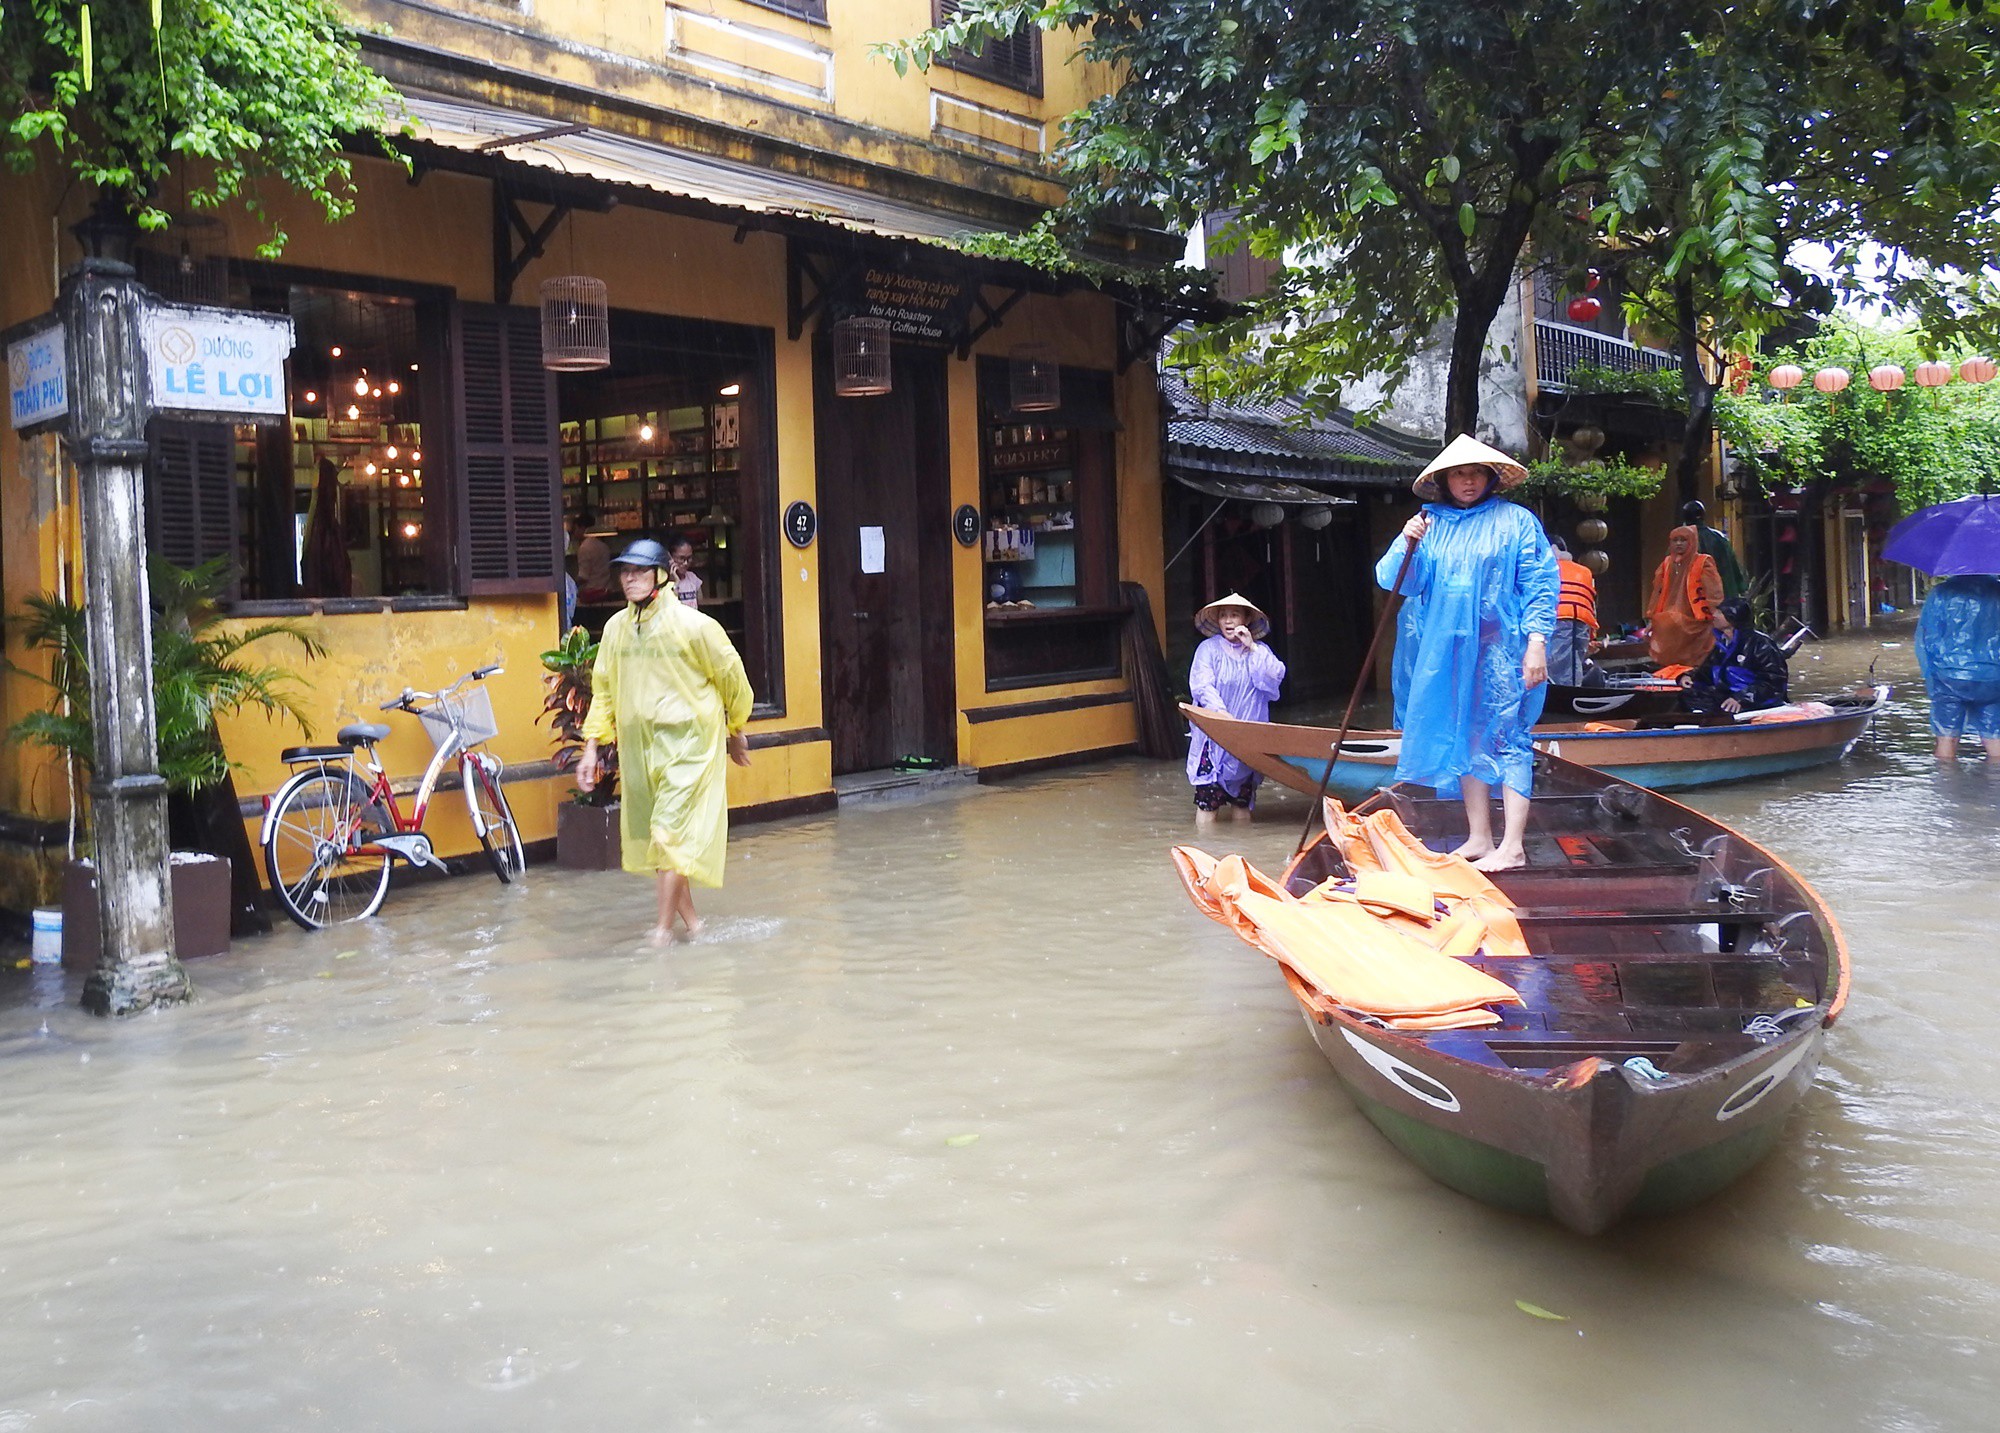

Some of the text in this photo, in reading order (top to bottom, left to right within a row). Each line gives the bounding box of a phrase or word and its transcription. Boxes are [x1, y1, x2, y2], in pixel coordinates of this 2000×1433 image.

[865, 288, 888, 303] rang
[890, 291, 908, 306] xay
[925, 295, 940, 309] An
[869, 304, 884, 316] Hoi
[884, 307, 897, 317] An
[897, 308, 932, 324] Roastery
[892, 320, 917, 334] Coffee
[917, 326, 942, 338] House
[41, 366, 64, 408] PHÚ
[165, 362, 274, 406] LÊ LỢI
[993, 447, 1061, 467] ROASTERY
[796, 515, 808, 527] 47
[963, 517, 973, 528] 47
